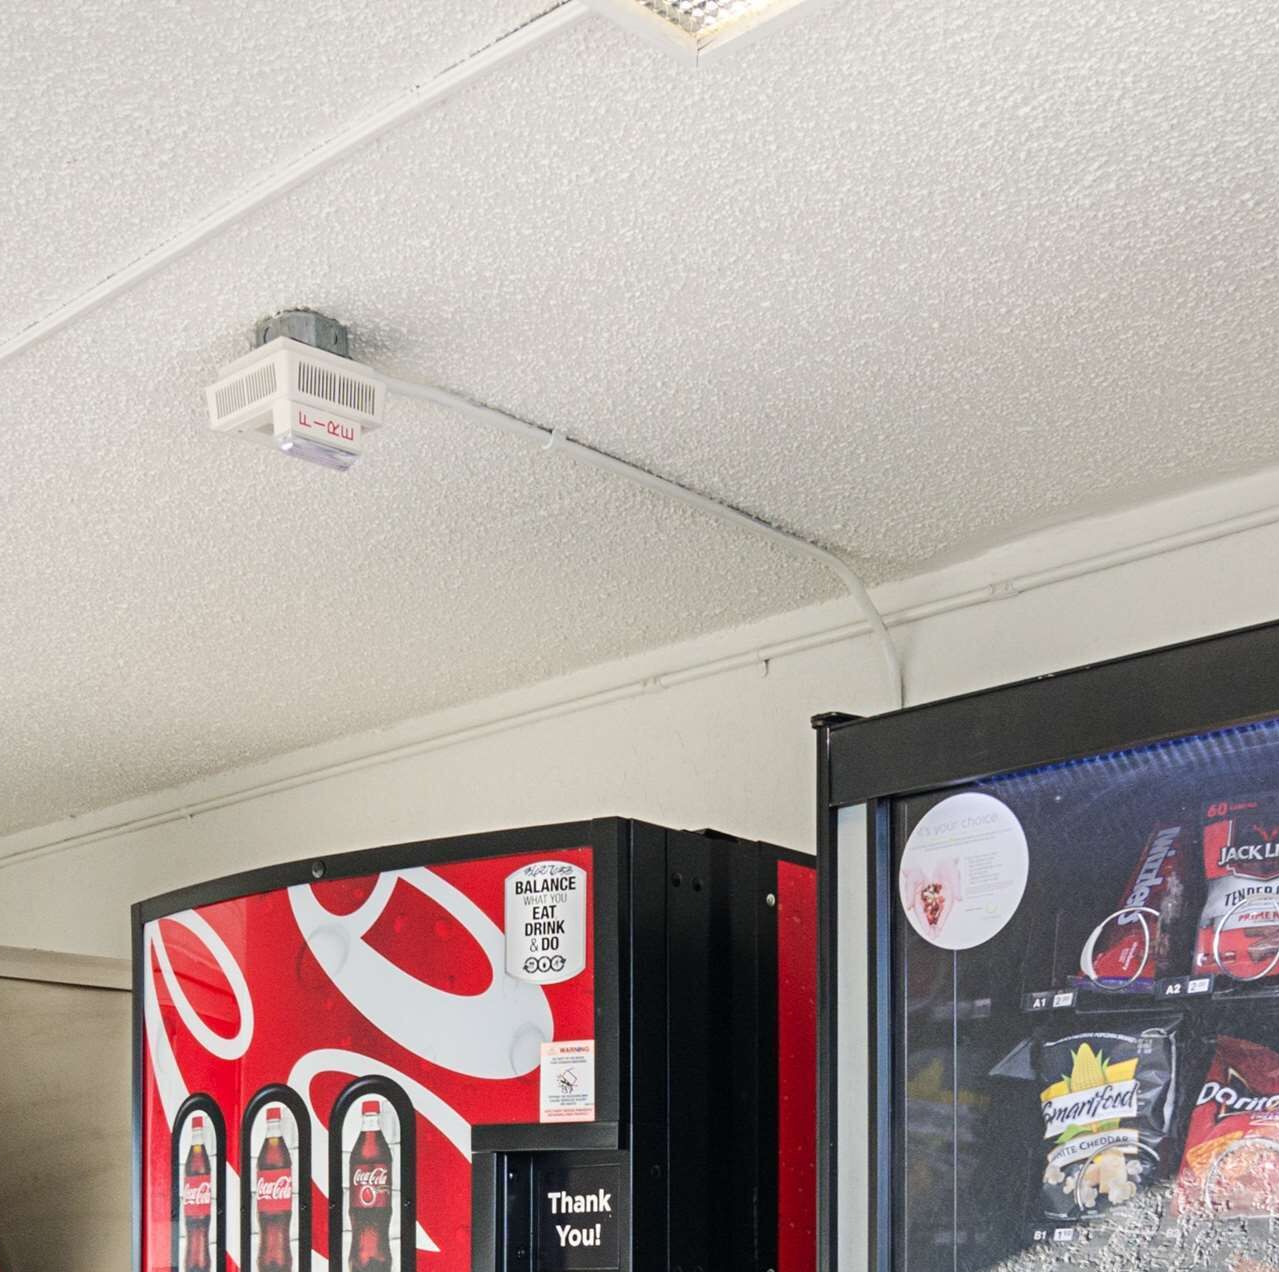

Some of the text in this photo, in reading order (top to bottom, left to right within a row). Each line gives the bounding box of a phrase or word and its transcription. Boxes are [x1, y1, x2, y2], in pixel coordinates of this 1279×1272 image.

[298, 410, 355, 441] FIRE
[1218, 845, 1264, 866] JACK
[515, 876, 576, 895] BALANCE
[523, 893, 568, 906] WHAT YOU
[532, 905, 557, 920] EAT
[525, 920, 565, 936] DRINK
[530, 936, 560, 952] & DO
[1165, 983, 1181, 994] A2
[1033, 998, 1046, 1008] A1
[1041, 1083, 1140, 1125] Smartfood
[1080, 1136, 1129, 1151] CHEDDAR
[353, 1167, 388, 1187] Coca-Cola
[183, 1182, 211, 1206] Coca-Cola
[257, 1176, 292, 1201] Coca-Cola
[547, 1188, 612, 1214] Thank
[556, 1223, 602, 1248] You!
[1034, 1230, 1047, 1241] B1
